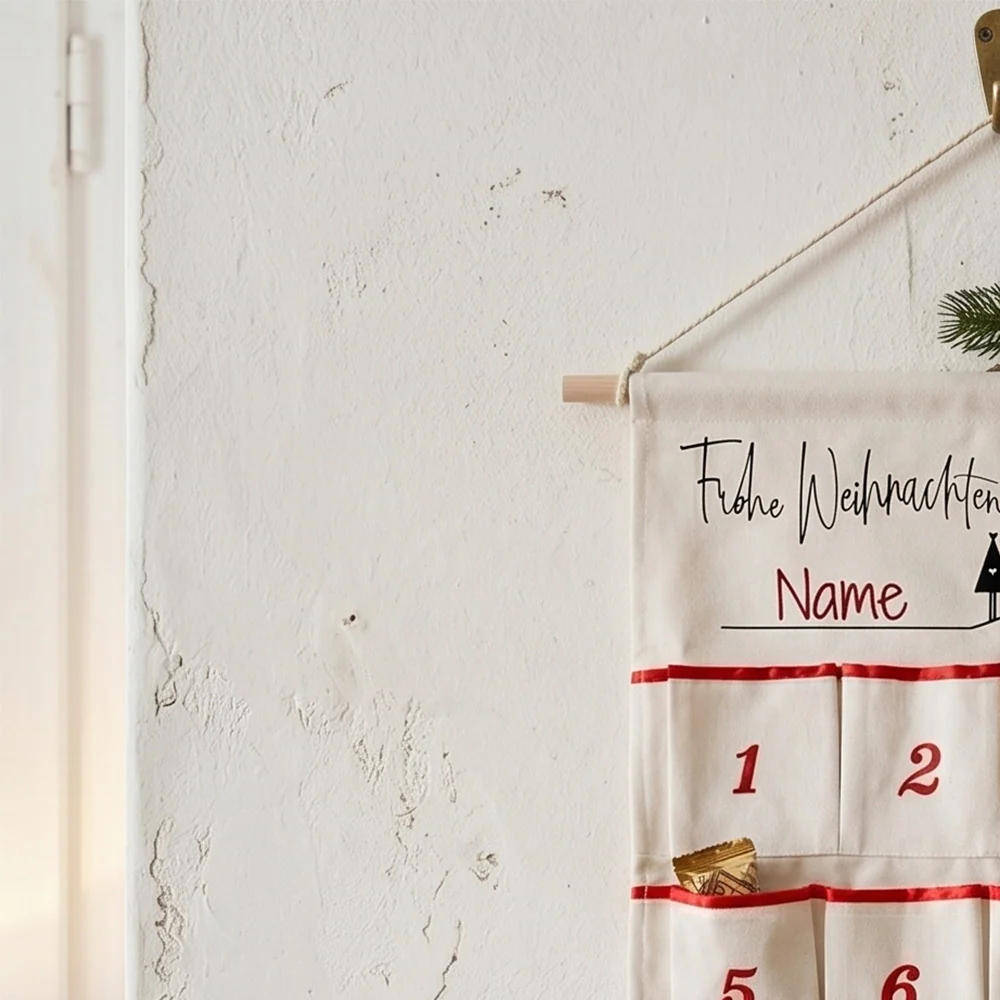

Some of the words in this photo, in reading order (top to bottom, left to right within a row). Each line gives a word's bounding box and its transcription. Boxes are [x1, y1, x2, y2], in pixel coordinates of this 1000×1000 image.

[679, 436, 785, 524] Frohe
[776, 567, 908, 621] Name
[733, 744, 759, 795] 1
[897, 742, 942, 797] 2
